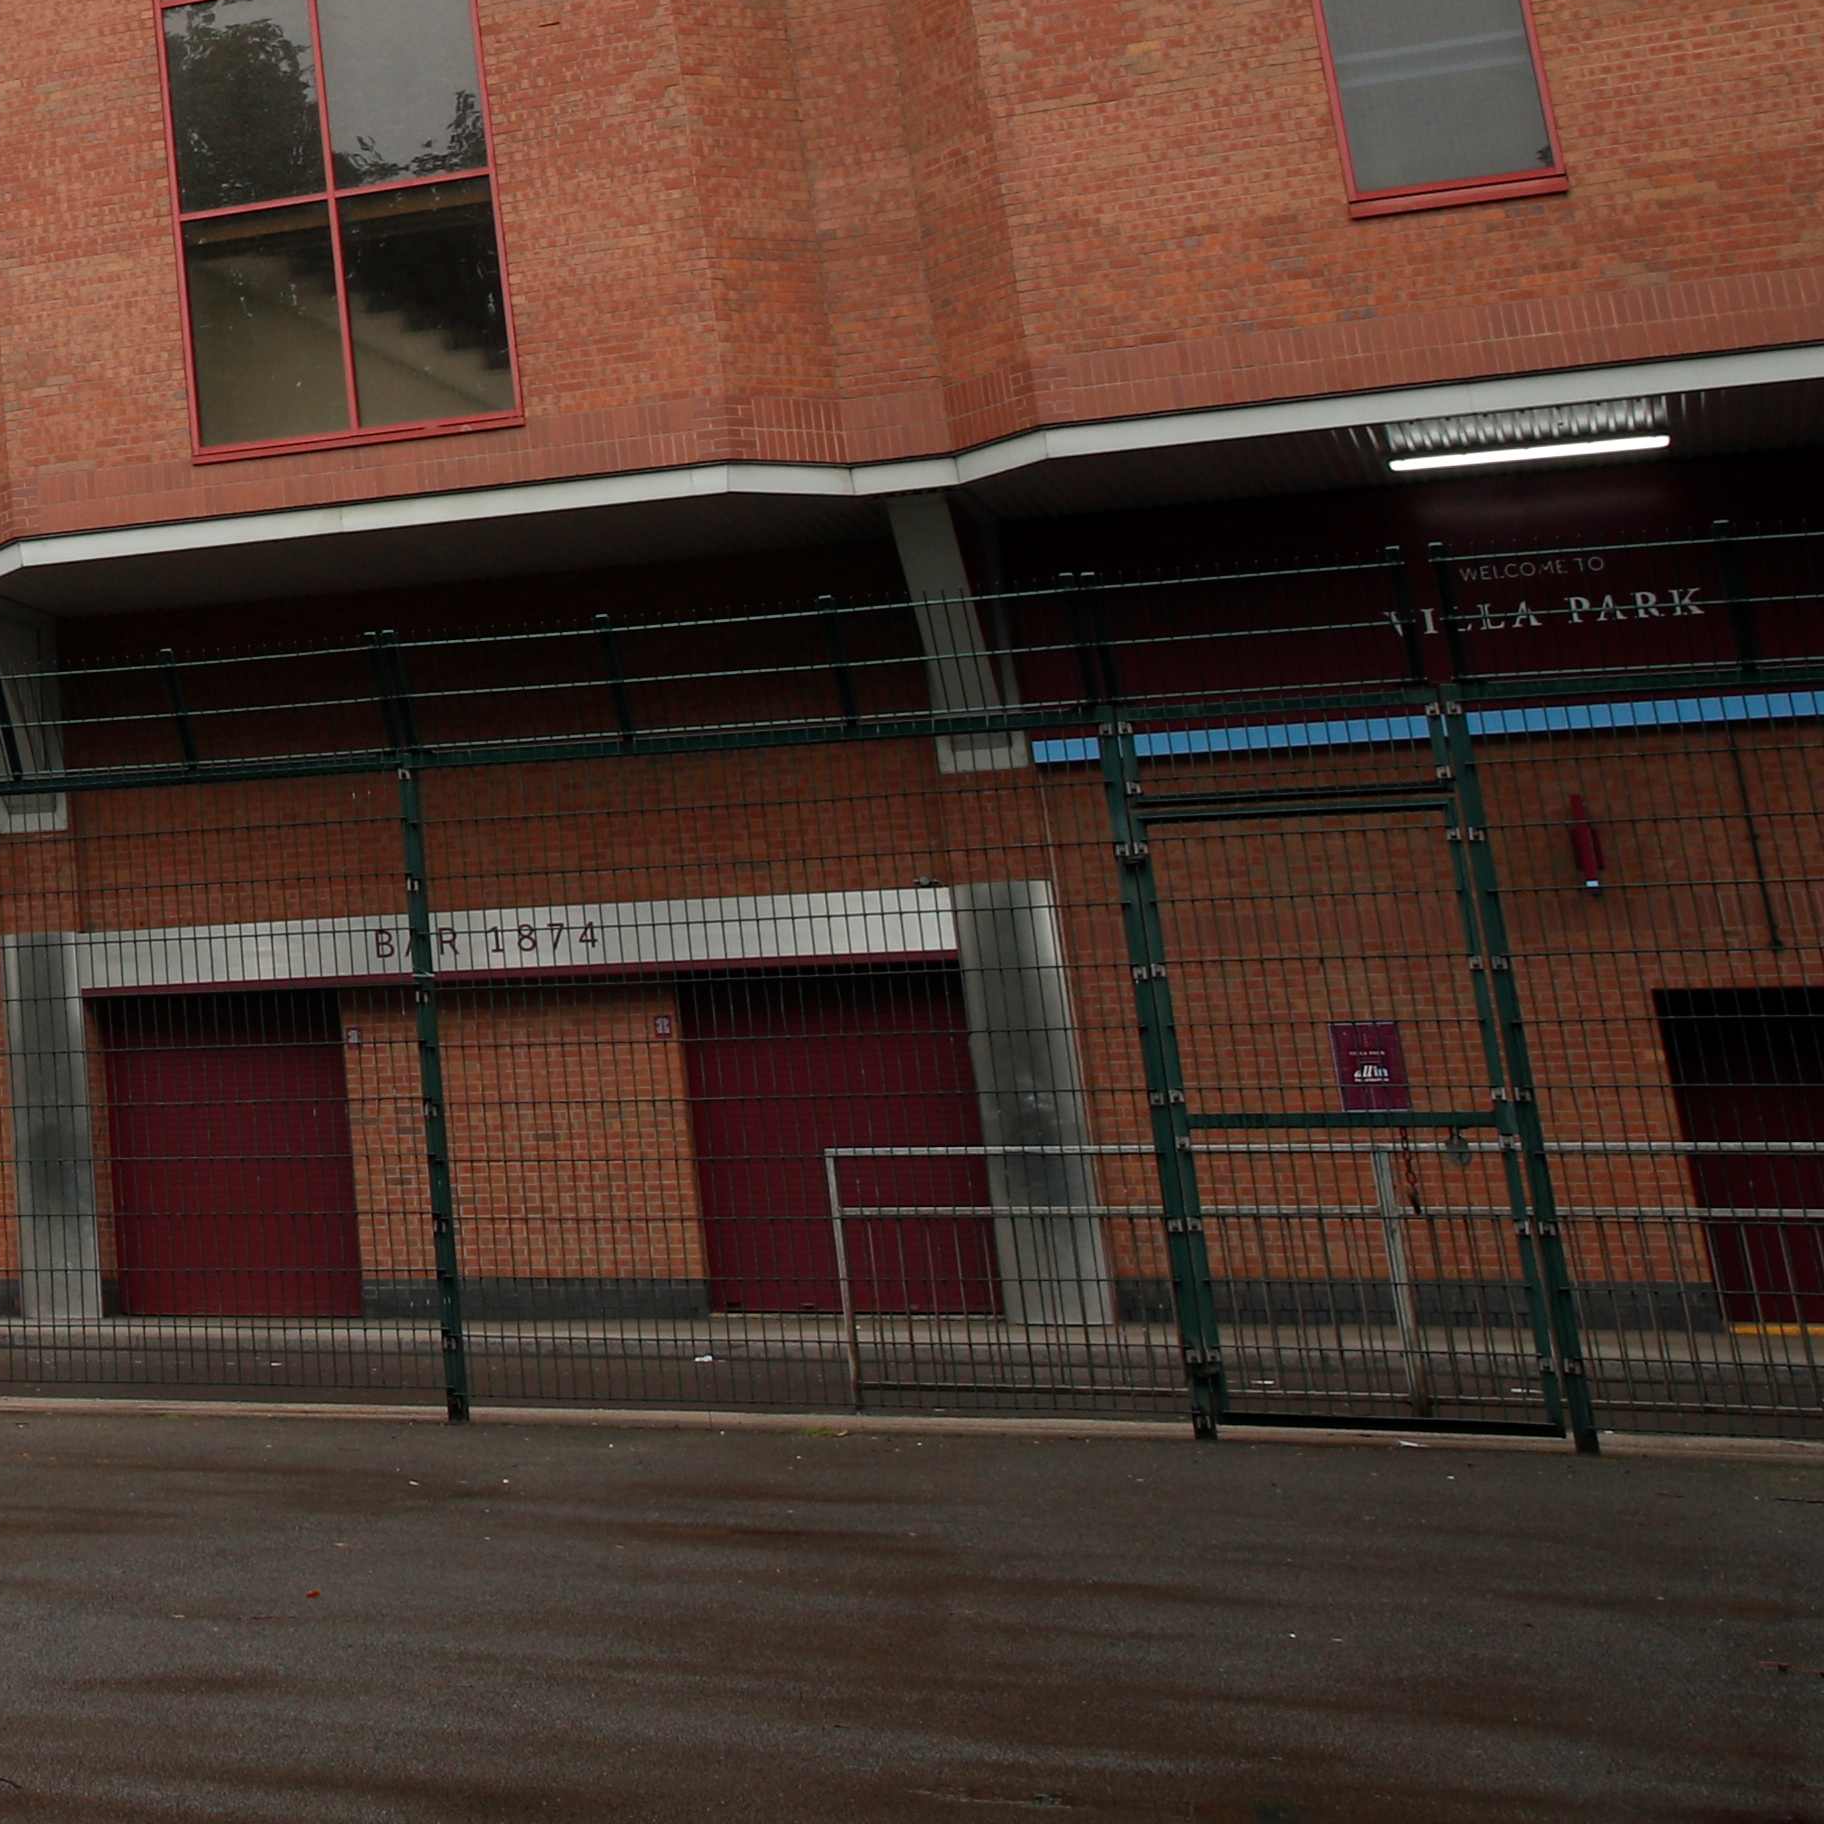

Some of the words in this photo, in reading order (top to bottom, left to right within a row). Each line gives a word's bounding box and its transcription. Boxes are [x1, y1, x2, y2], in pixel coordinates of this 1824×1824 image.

[1458, 560, 1569, 583] WELCOME
[1576, 556, 1606, 572] TO
[1563, 587, 1706, 624] PARK
[488, 921, 599, 953] 1874
